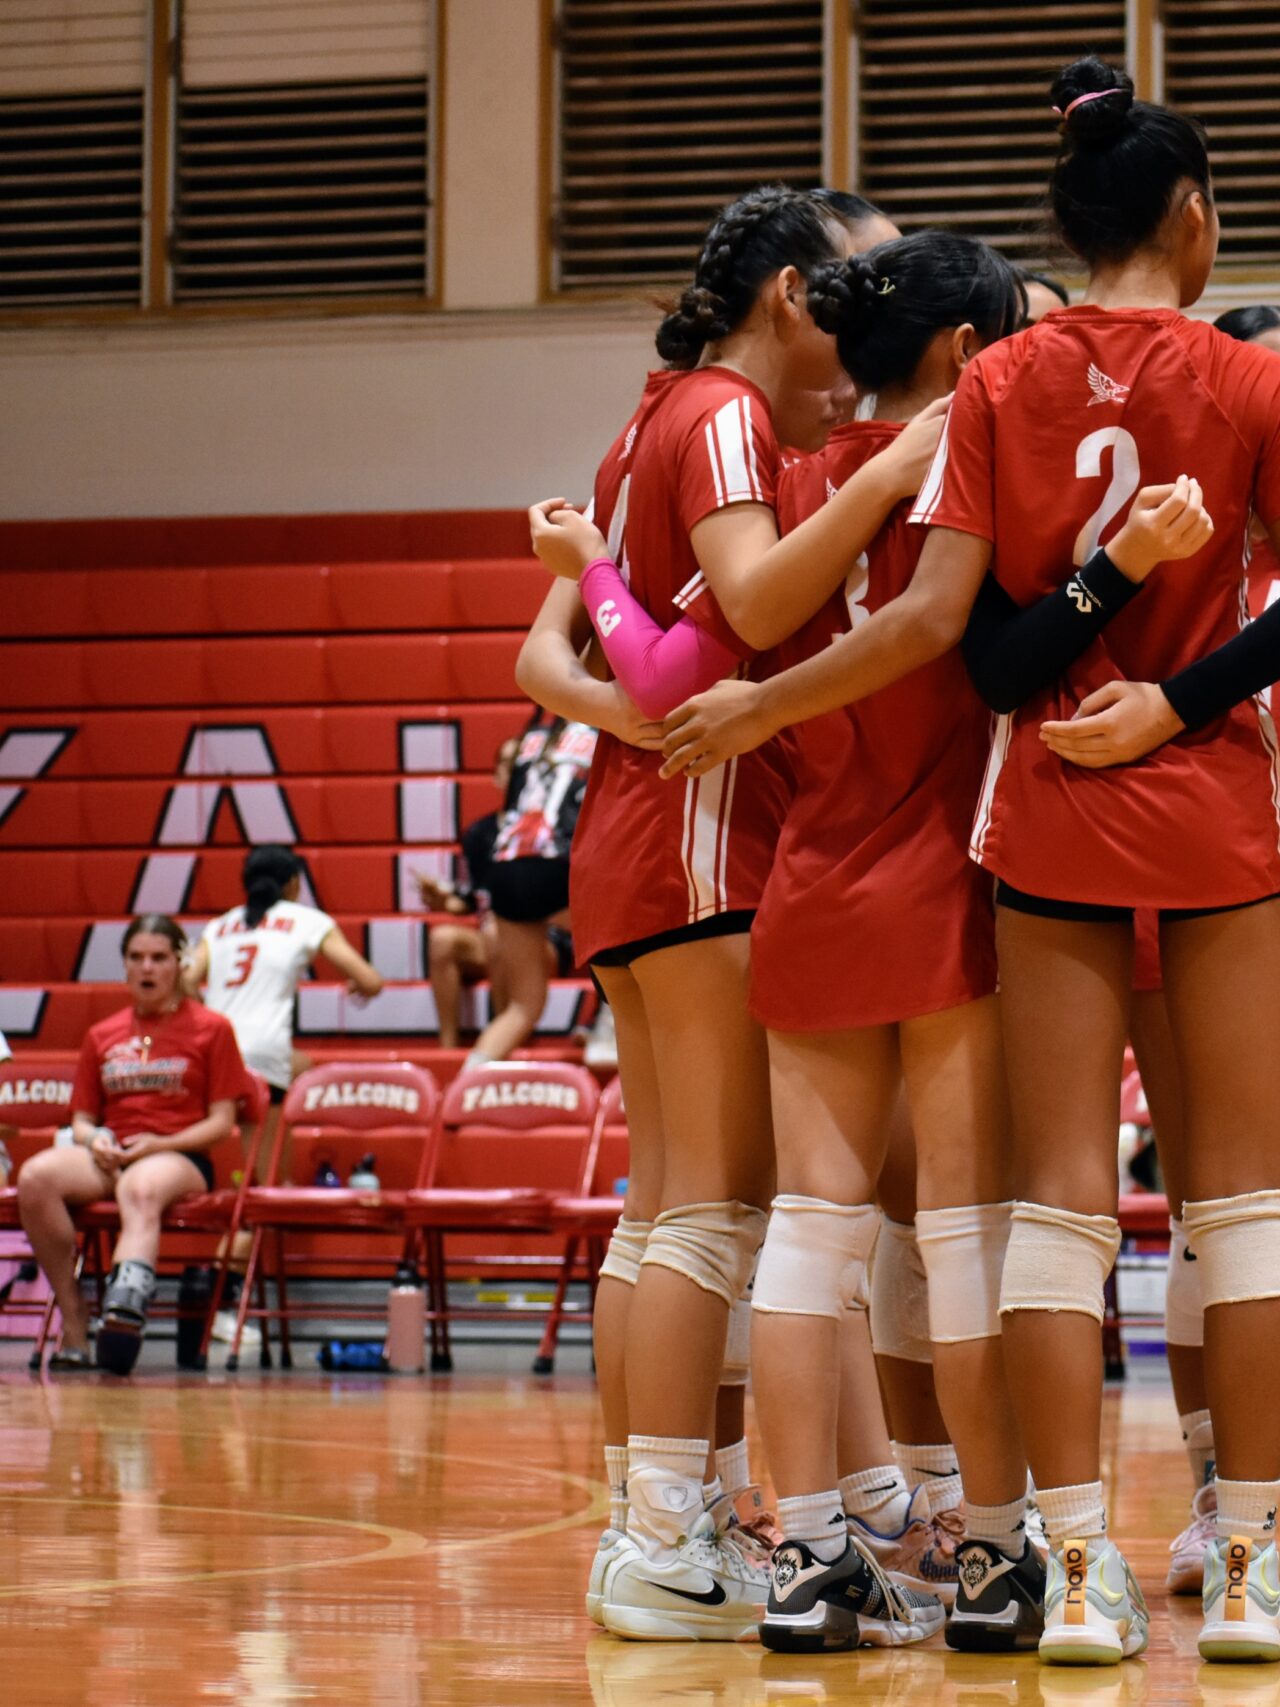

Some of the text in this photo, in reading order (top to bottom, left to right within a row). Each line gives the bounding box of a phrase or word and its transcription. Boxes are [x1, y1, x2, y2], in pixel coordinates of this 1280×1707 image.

[1073, 425, 1140, 568] 2
[225, 944, 258, 988] 3
[304, 1081, 419, 1113] FALCONS
[462, 1080, 579, 1113] FALCONS
